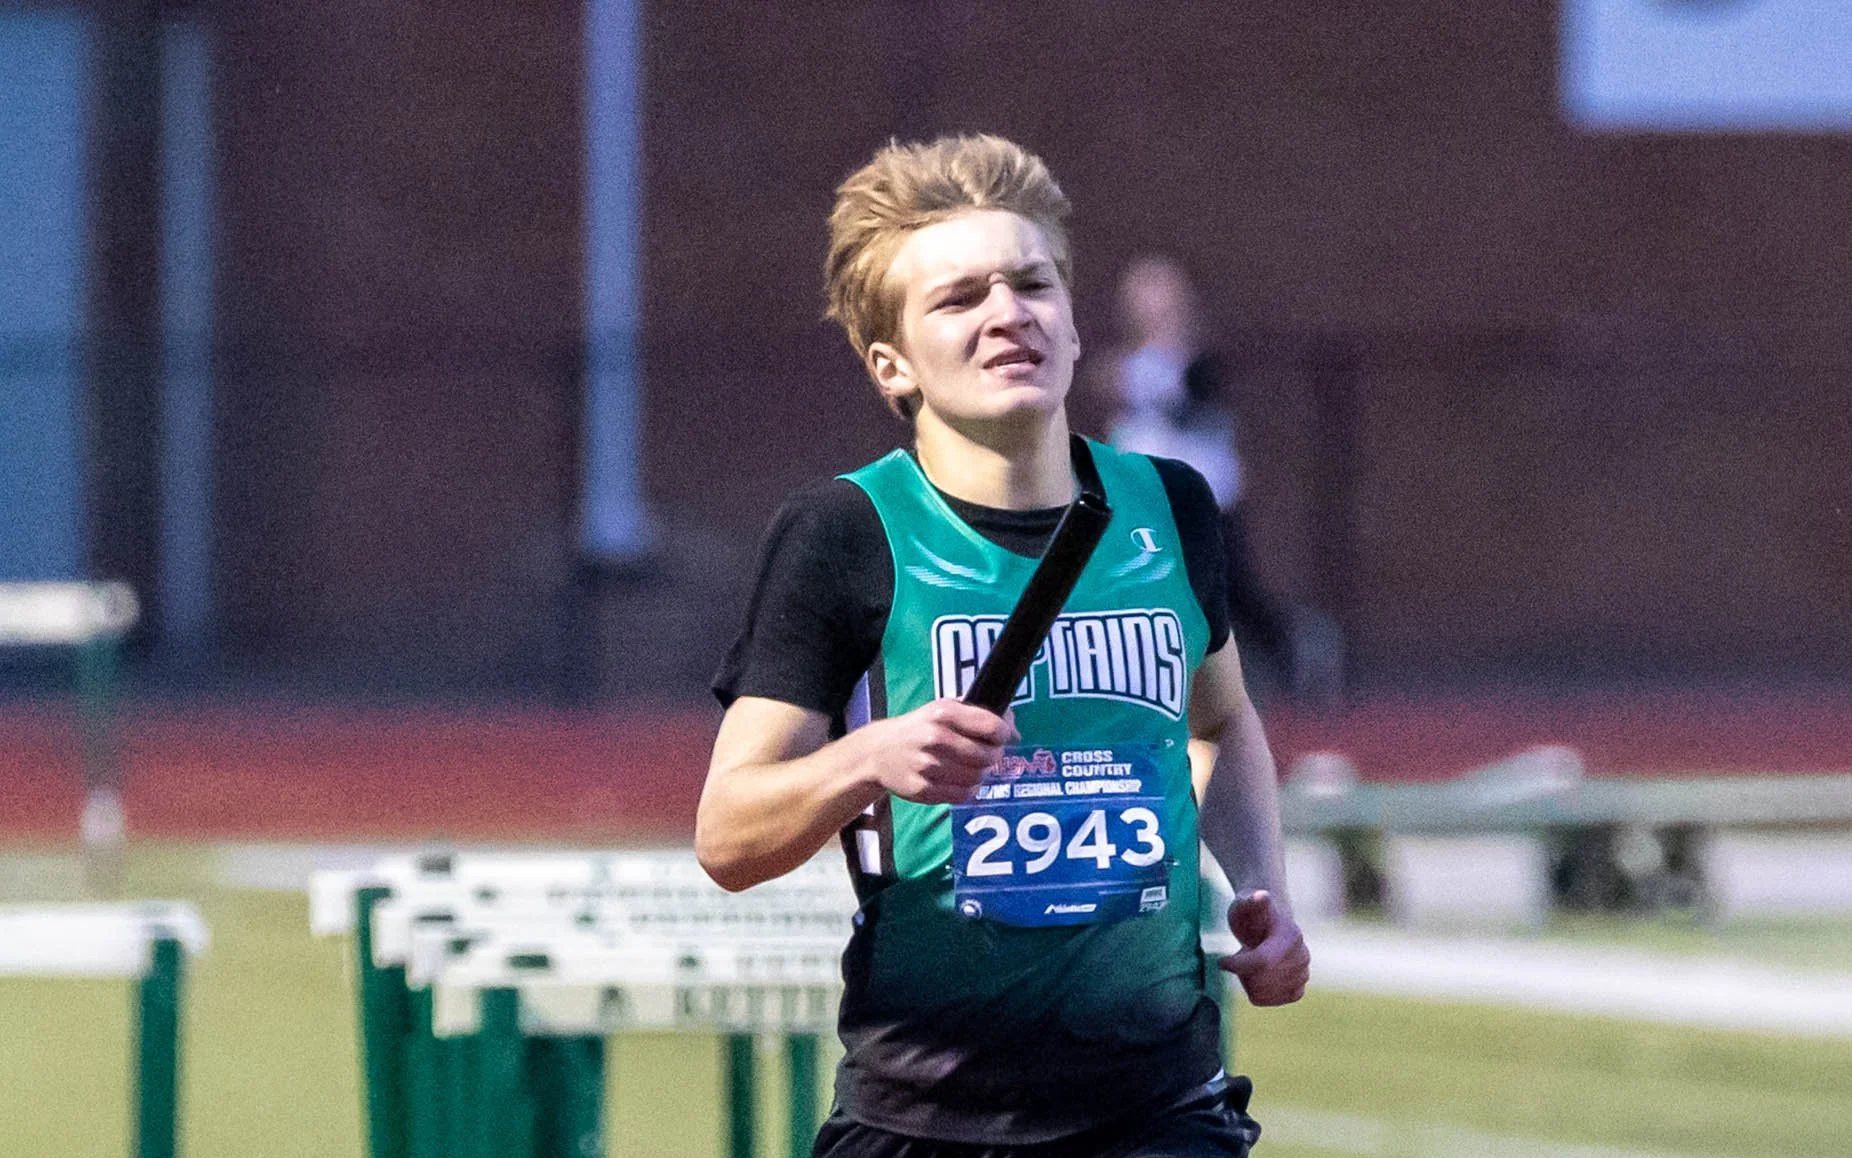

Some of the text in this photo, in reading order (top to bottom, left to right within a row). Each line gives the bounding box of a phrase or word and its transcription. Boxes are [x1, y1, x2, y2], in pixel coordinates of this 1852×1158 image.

[931, 608, 1187, 721] CTAINS
[1061, 750, 1113, 764] CROSS
[1062, 763, 1132, 777] COUNTRY
[1013, 782, 1064, 798] REGIONAL
[1064, 779, 1142, 796] CHAMPIONSHIP
[964, 807, 1165, 877] 2943
